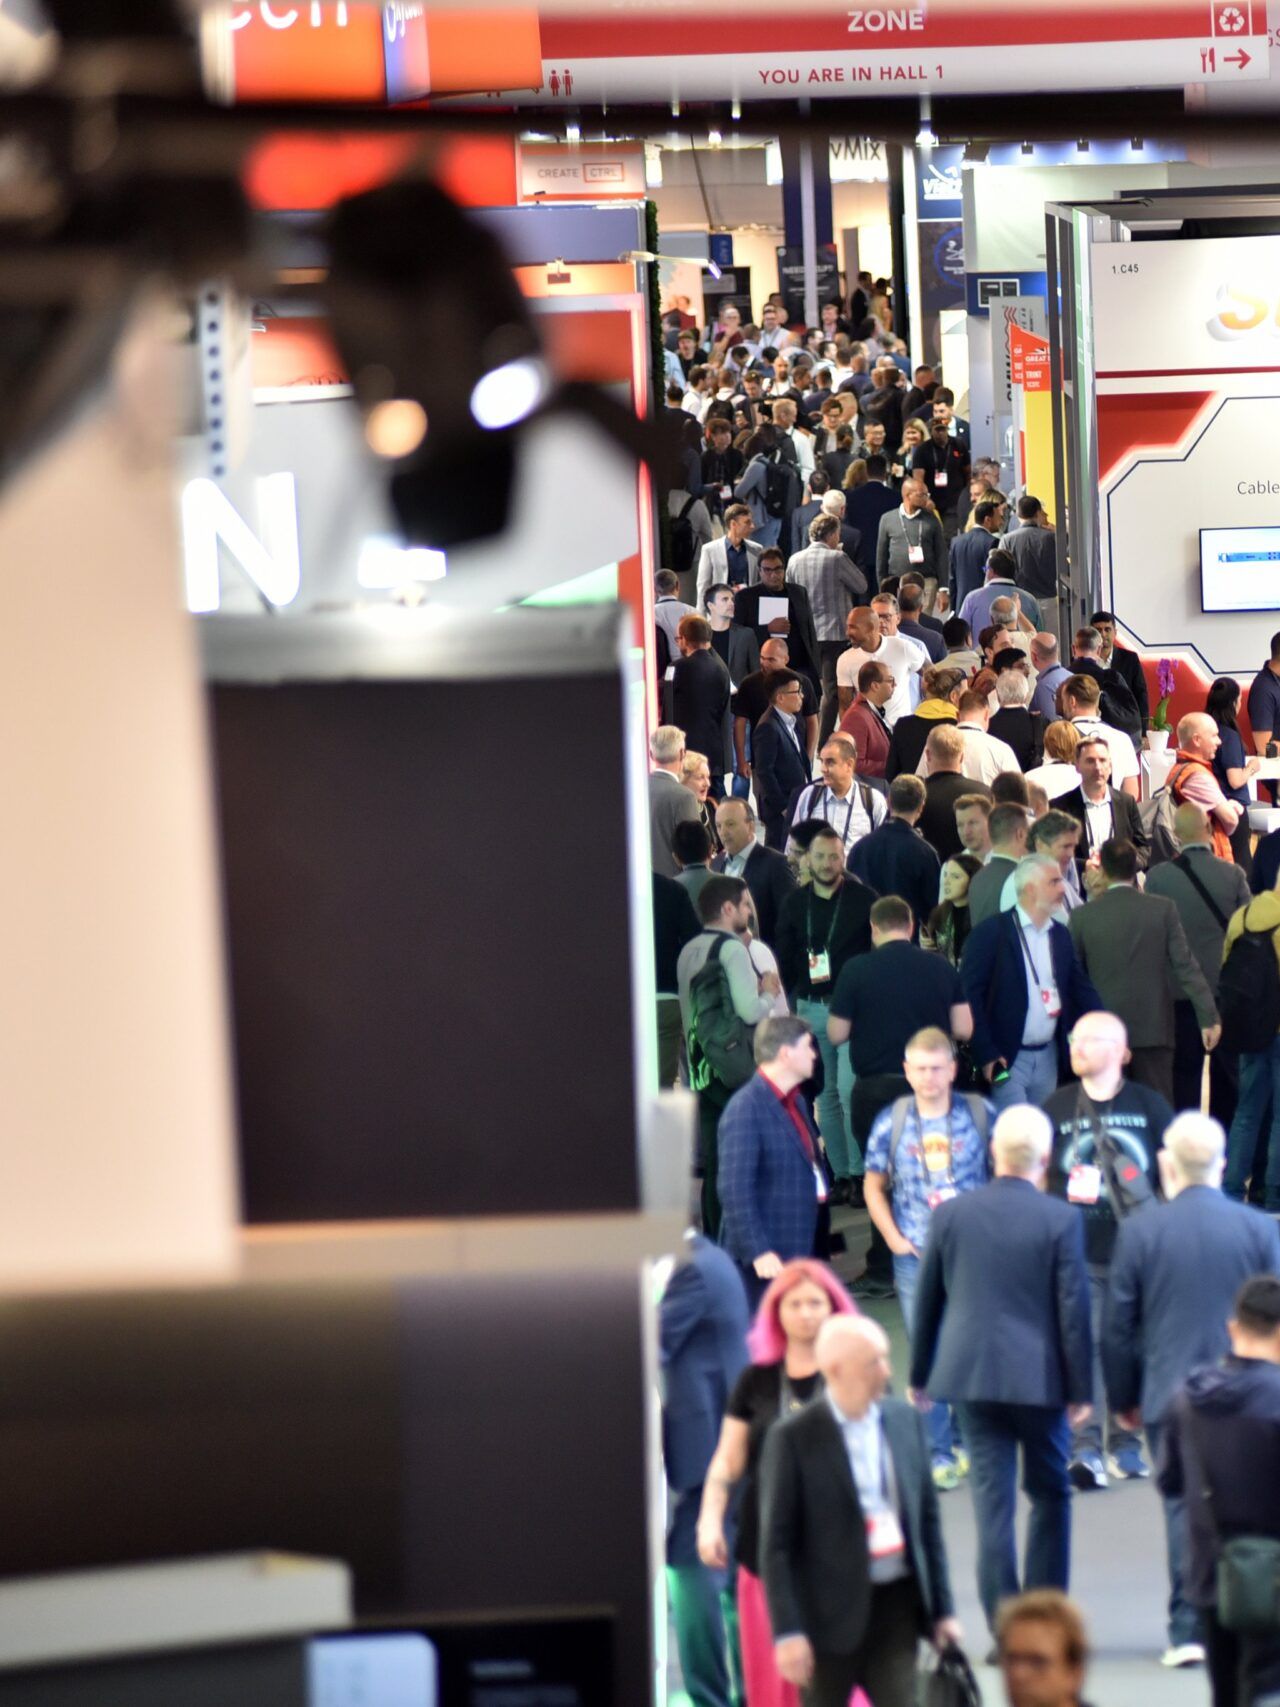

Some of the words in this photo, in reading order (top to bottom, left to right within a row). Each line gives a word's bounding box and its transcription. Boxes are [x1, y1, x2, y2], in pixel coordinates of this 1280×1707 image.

[848, 9, 924, 32] ZONE
[759, 69, 799, 84] YOU
[808, 68, 844, 83] ARE
[852, 66, 872, 81] IN
[880, 65, 927, 80] HALL
[936, 65, 943, 79] 1
[537, 167, 579, 179] CREATE
[589, 167, 618, 178] CTRL
[1112, 263, 1139, 274] 1.C45
[1237, 480, 1280, 495] Cable
